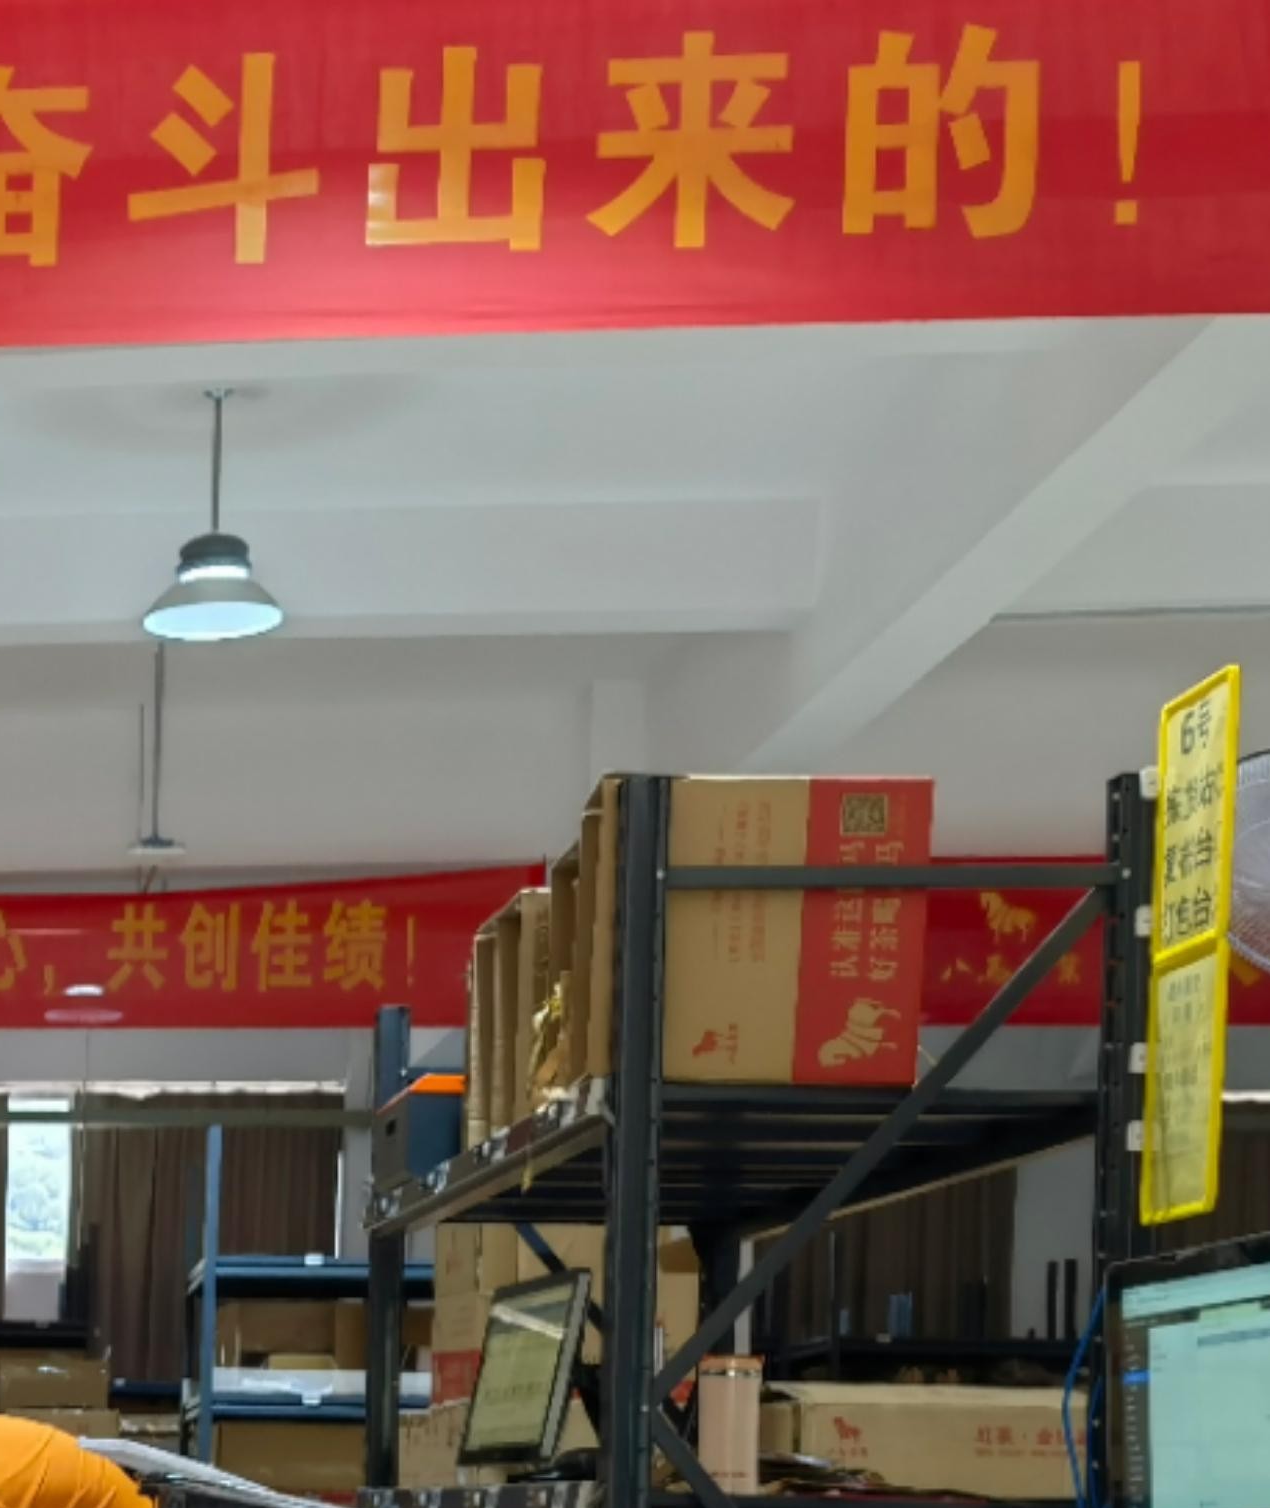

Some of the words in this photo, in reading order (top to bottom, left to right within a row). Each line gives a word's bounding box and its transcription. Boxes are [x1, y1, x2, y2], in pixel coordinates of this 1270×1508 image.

[829, 839, 865, 980] 认准这马
[869, 841, 905, 983] 好茶喝马
